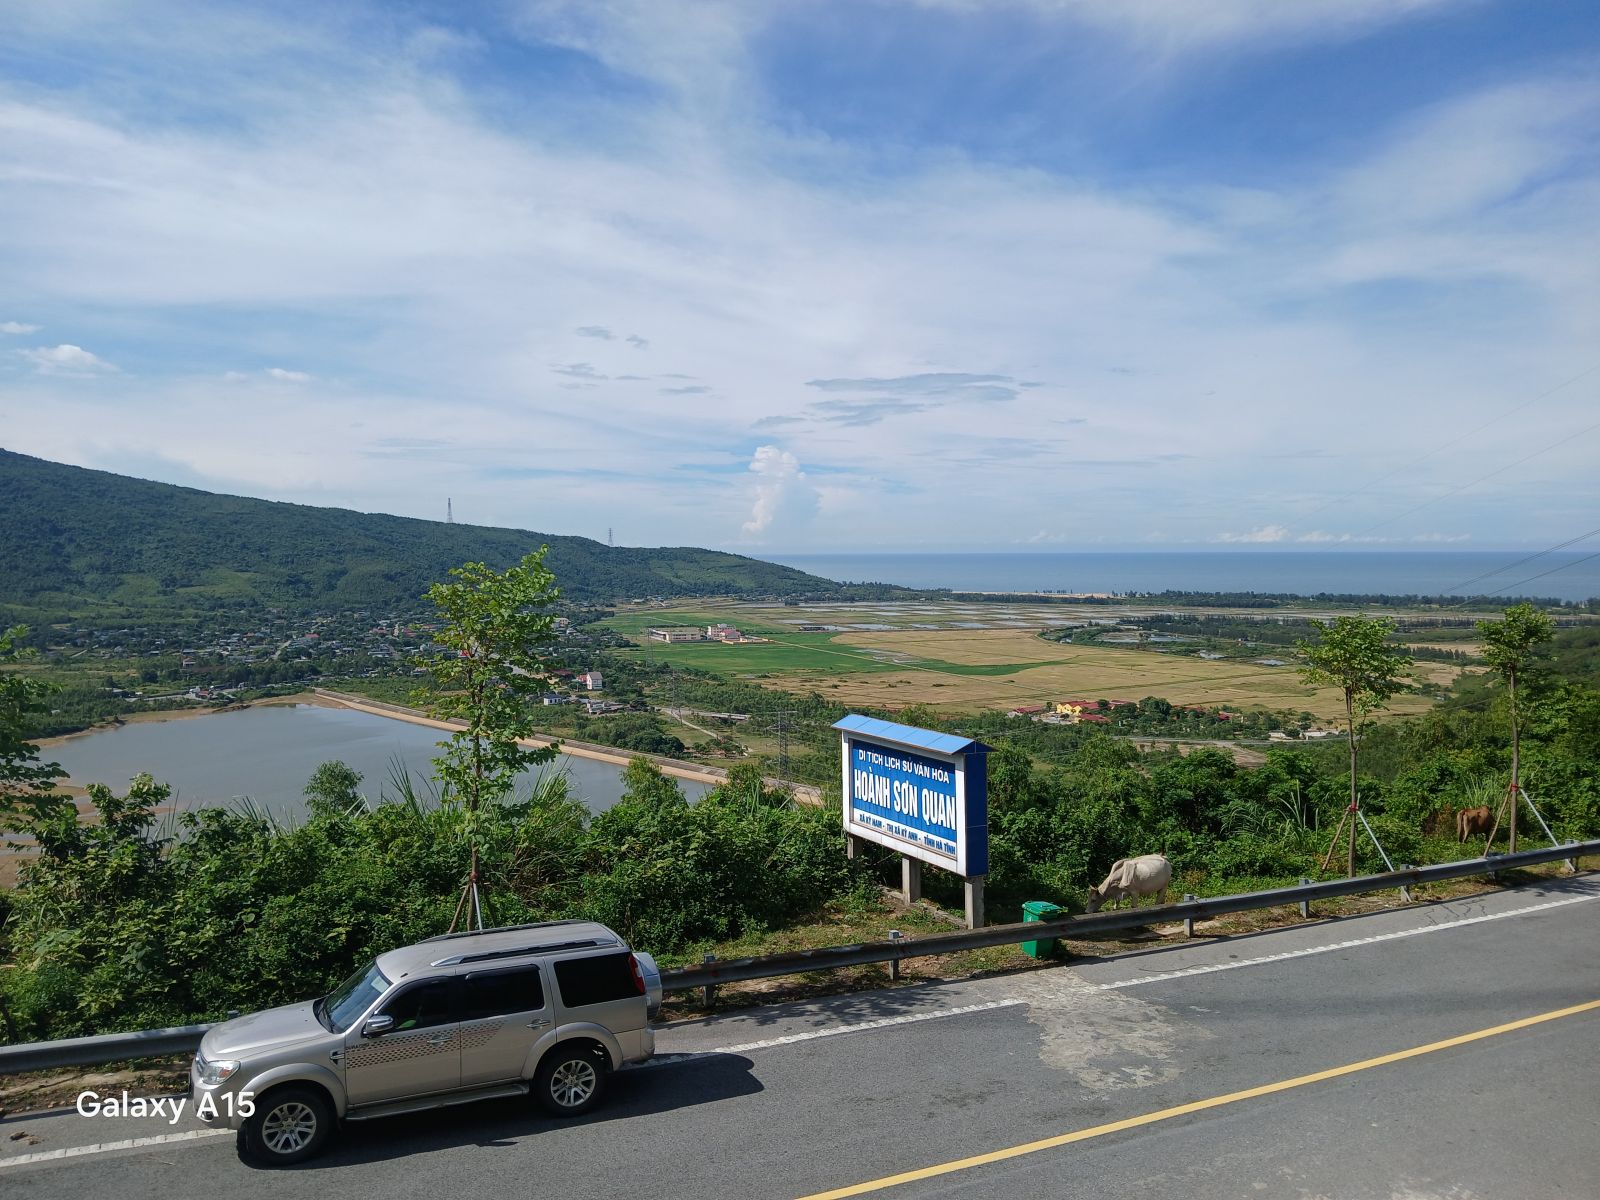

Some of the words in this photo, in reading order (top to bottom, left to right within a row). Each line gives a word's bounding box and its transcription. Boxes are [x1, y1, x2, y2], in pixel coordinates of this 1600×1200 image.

[858, 749, 866, 761] DI
[884, 755, 900, 770] LỊCH
[914, 761, 930, 779] VĂN
[931, 767, 950, 784] HÓA
[854, 766, 891, 809] HOÀNH
[893, 779, 918, 818] SƠN
[921, 788, 957, 831] QUAN
